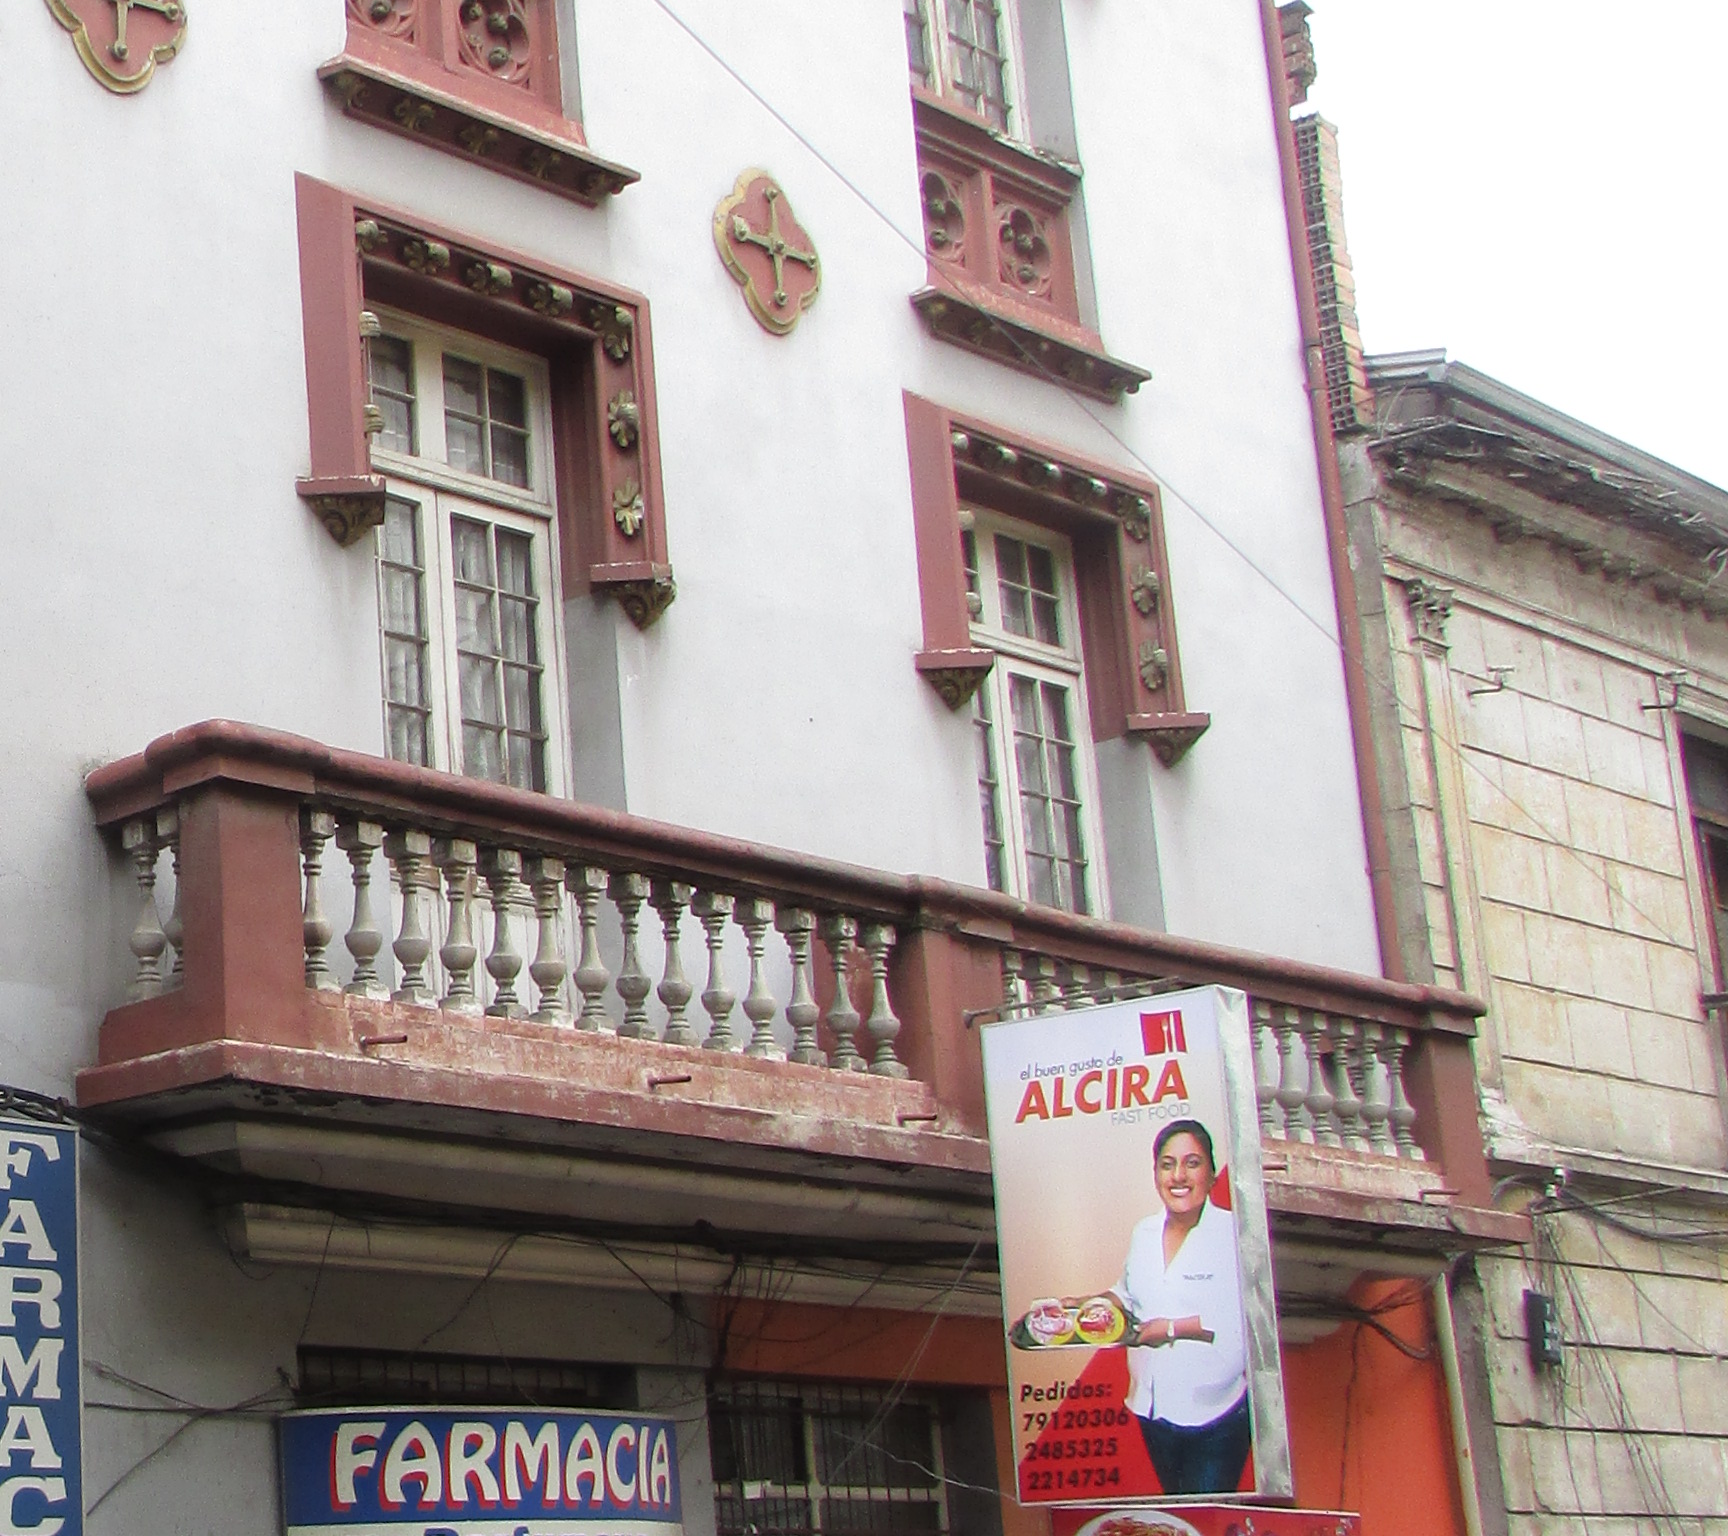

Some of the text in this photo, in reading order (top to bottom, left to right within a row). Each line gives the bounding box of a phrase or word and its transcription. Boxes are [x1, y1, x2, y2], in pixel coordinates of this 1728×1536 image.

[1019, 1049, 1124, 1080] el buen gusto de
[1014, 1059, 1189, 1124] ALCIRA
[1111, 1103, 1191, 1126] FAST FOOD
[1020, 1379, 1112, 1402] Pedidos:
[1023, 1408, 1129, 1431] 79120306
[1025, 1438, 1118, 1461] 2485325
[330, 1421, 672, 1512] FARMACIA
[1028, 1467, 1120, 1491] 2214734
